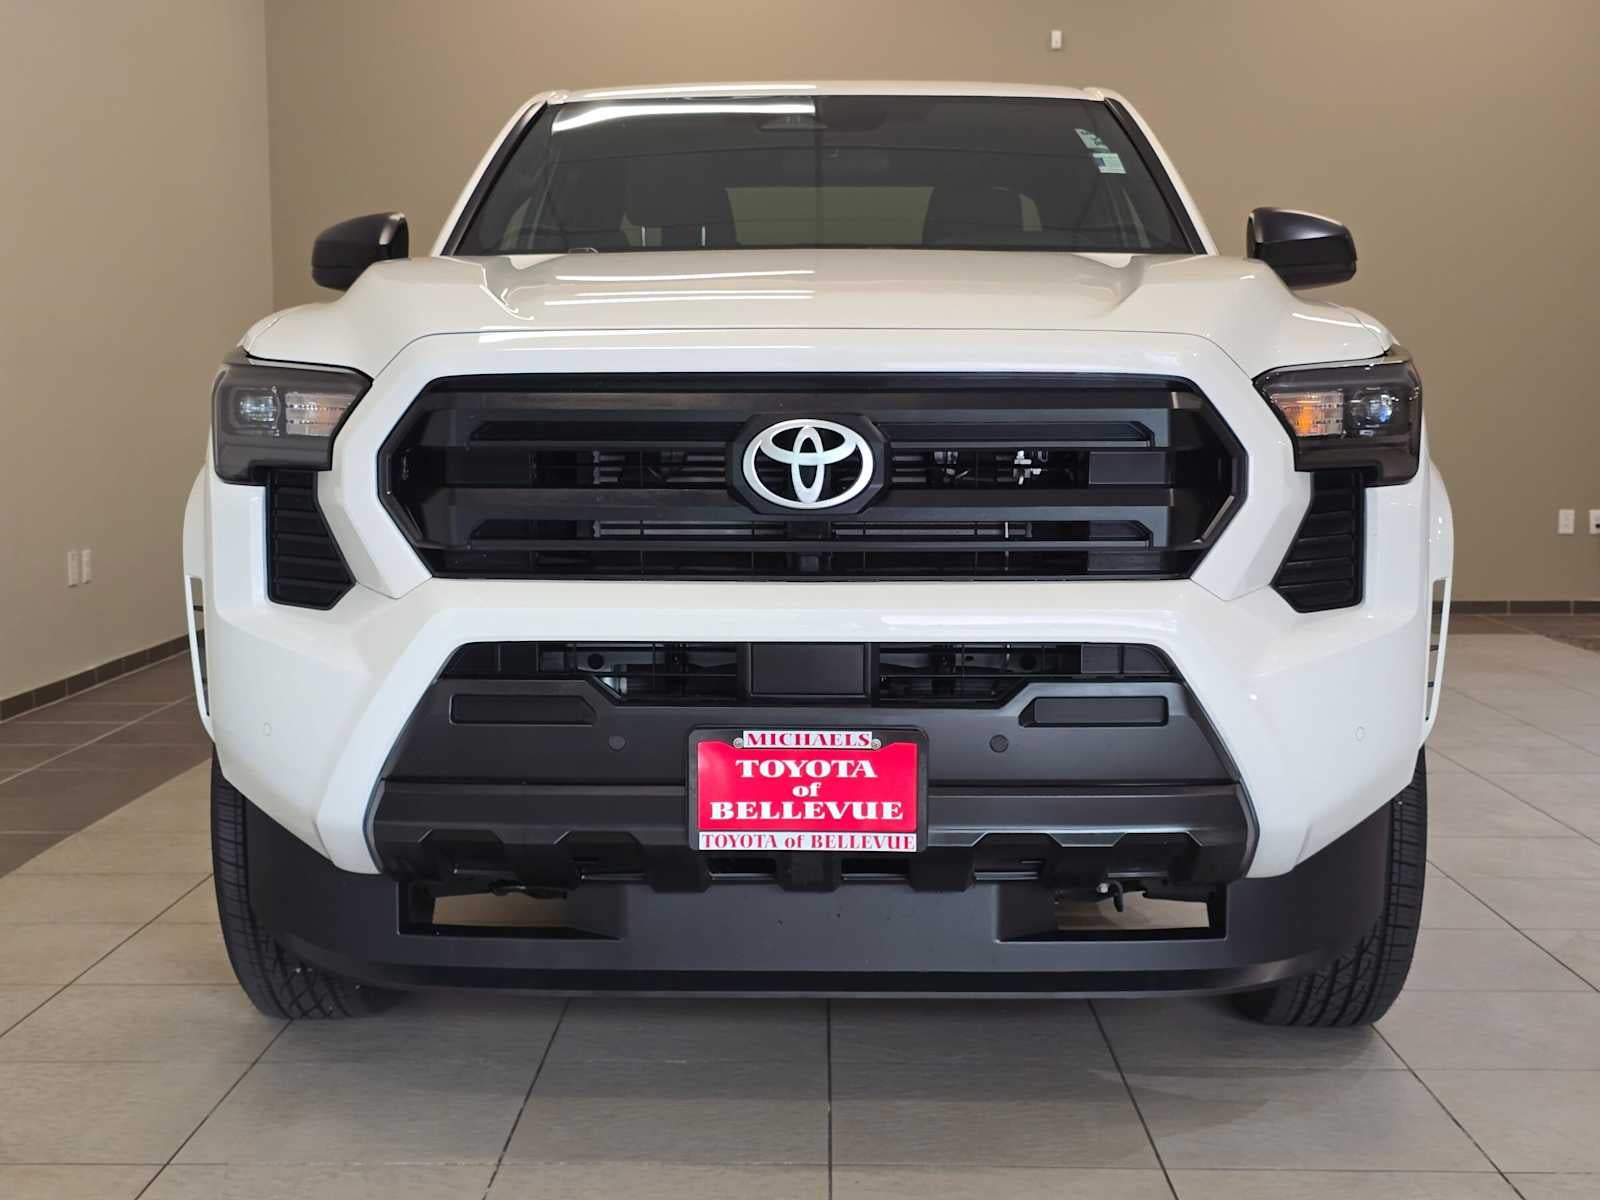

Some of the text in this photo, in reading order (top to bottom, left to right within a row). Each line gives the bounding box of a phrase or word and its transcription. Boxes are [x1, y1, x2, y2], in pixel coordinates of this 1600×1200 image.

[747, 732, 871, 747] MICHAELS
[735, 759, 878, 778] TOYOTA
[792, 782, 822, 797] of
[709, 801, 904, 821] BELLEVUE
[701, 834, 915, 850] TOYOTA of BELLEVUE
